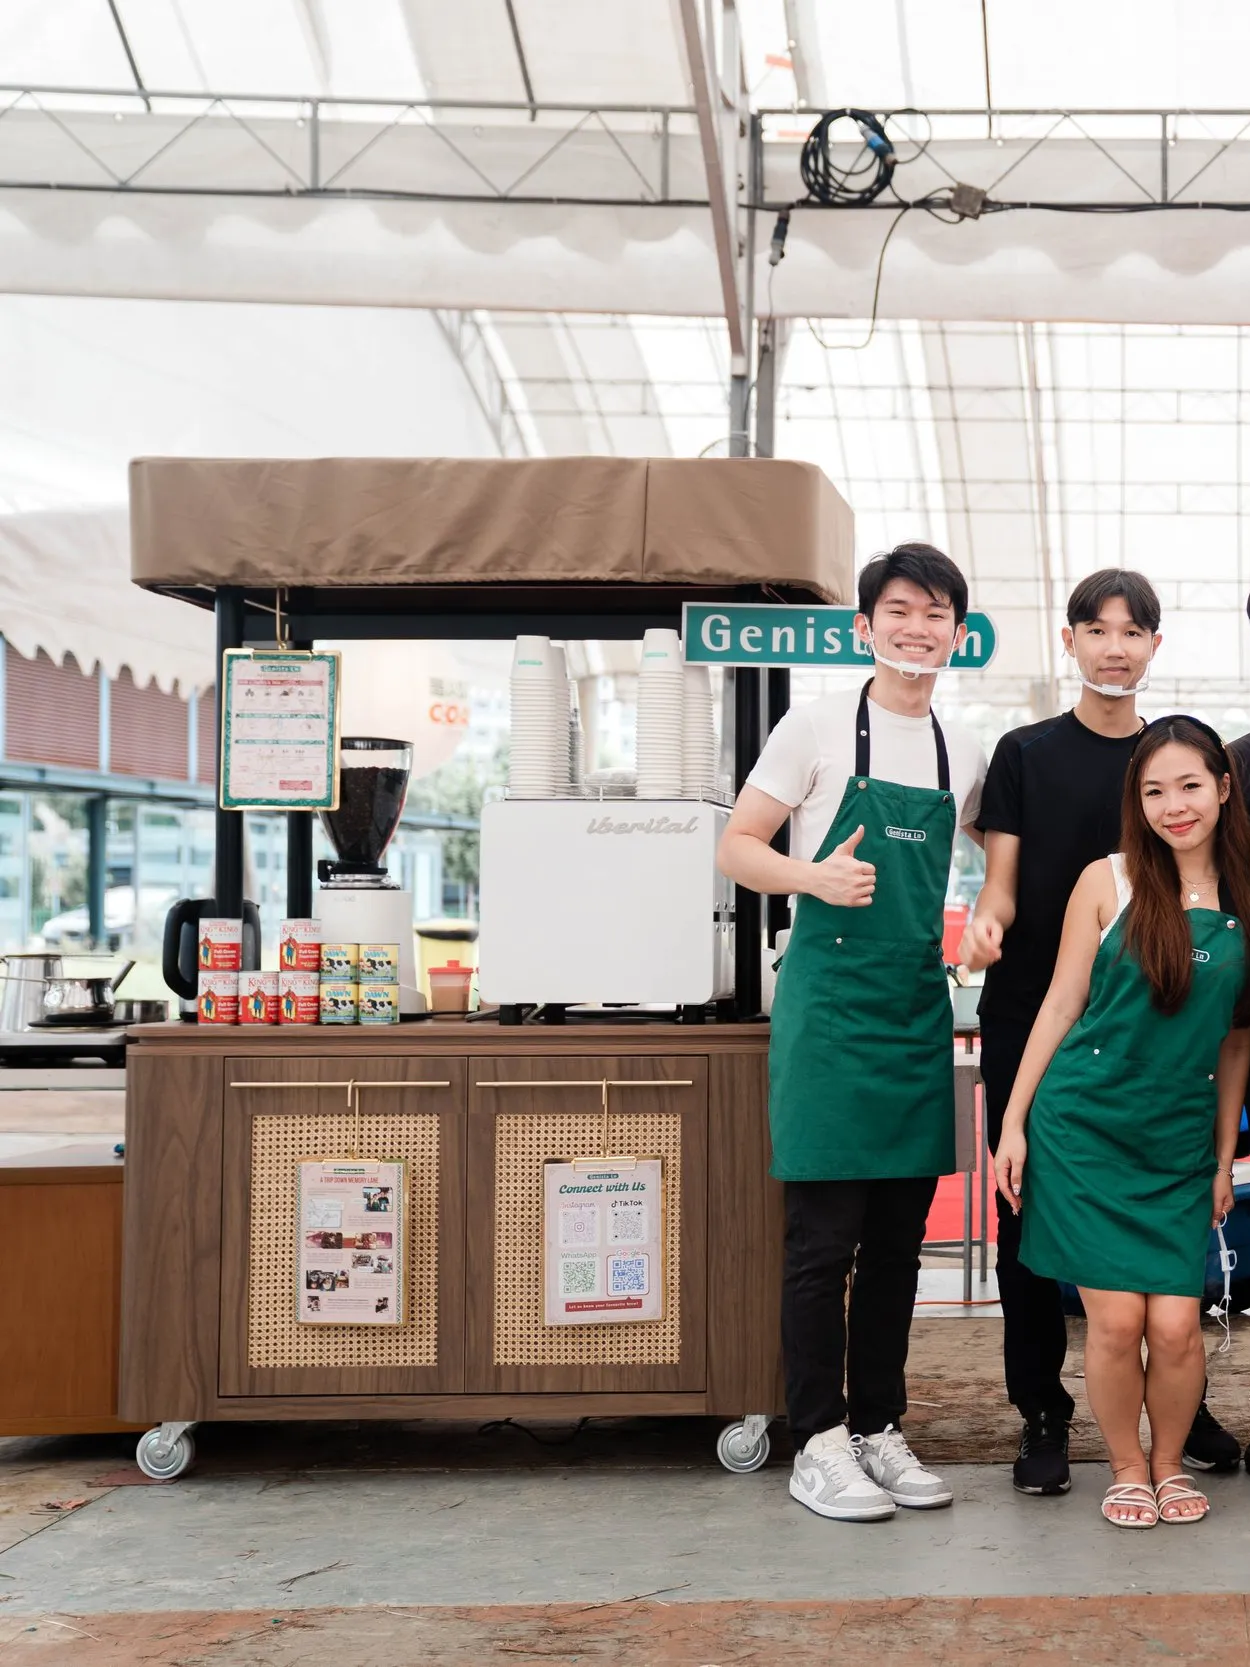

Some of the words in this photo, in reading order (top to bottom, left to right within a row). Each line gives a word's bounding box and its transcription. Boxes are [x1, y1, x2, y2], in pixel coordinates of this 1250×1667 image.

[701, 614, 866, 655] Genist
[958, 631, 982, 657] n
[586, 816, 699, 834] iberital
[889, 828, 911, 838] Genista
[559, 1184, 604, 1194] Connect
[606, 1182, 629, 1192] with
[632, 1182, 646, 1191] Us
[561, 1201, 596, 1210] Instagram
[561, 1251, 597, 1259] WhatsApp
[616, 1249, 640, 1258] Gogle
